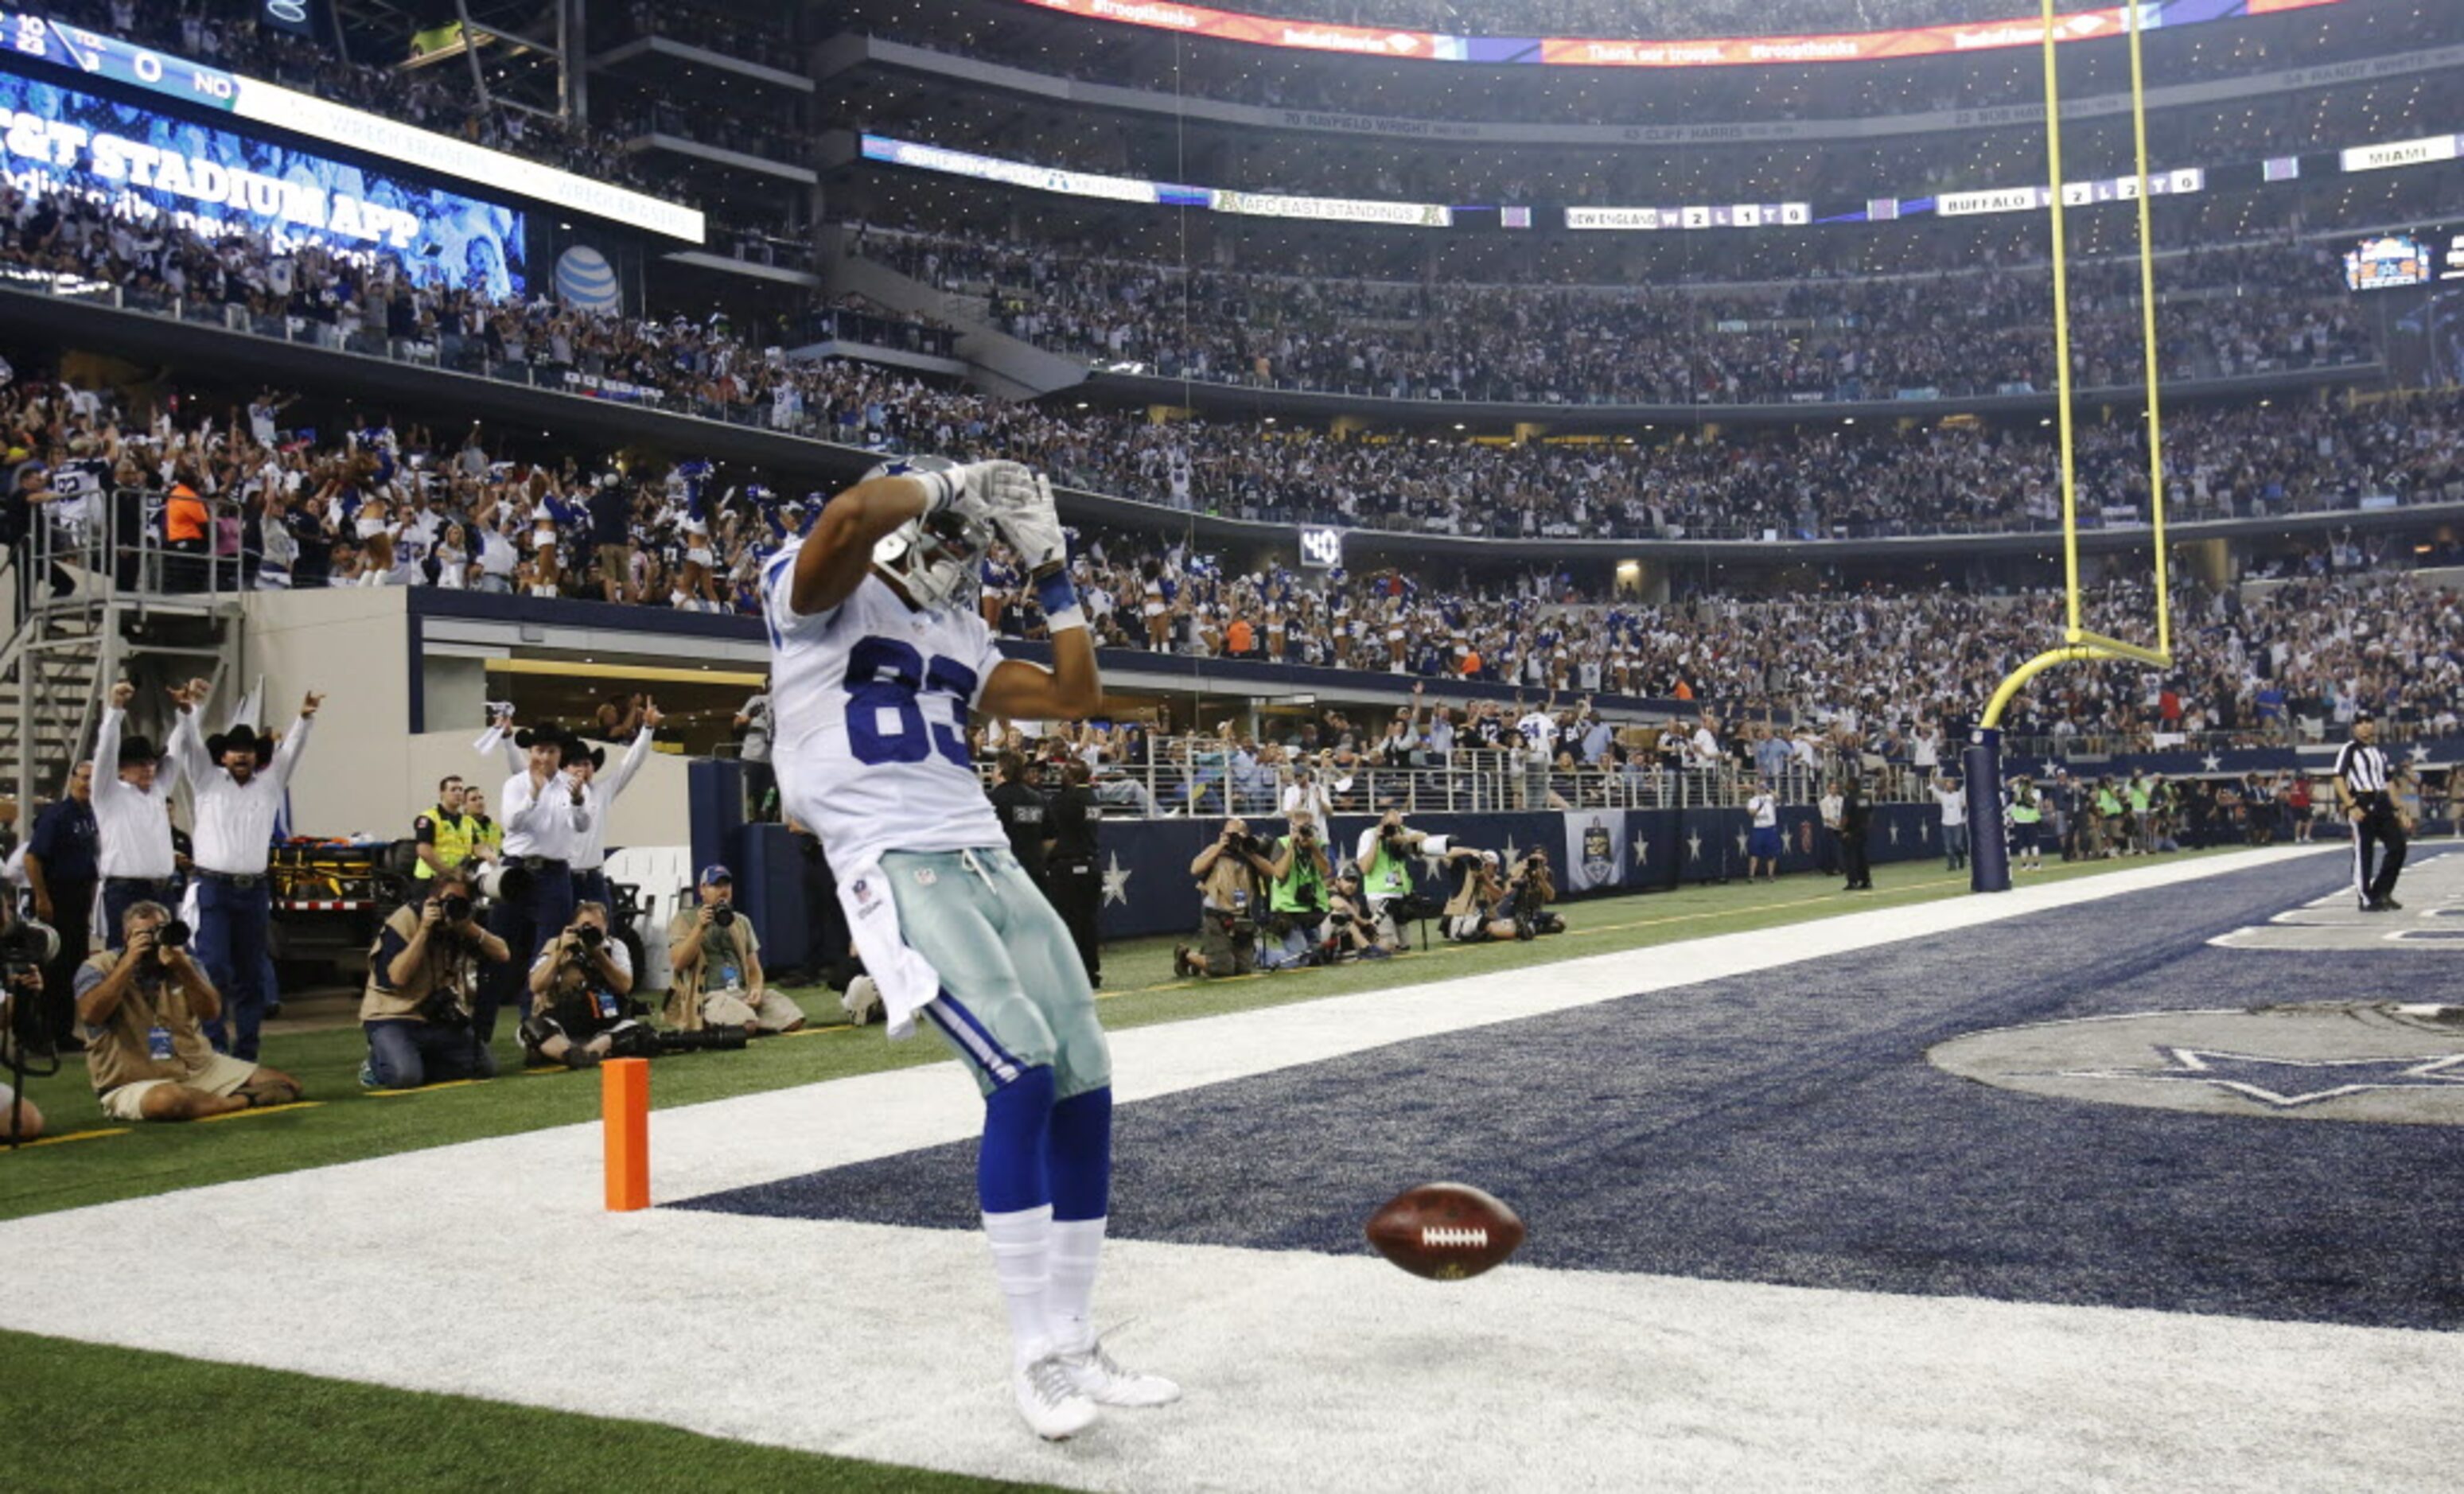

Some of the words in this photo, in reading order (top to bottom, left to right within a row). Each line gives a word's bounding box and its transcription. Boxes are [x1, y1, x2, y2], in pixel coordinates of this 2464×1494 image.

[1588, 45, 1635, 61] Thank
[193, 71, 232, 99] NO
[1285, 113, 1300, 125] 70
[1376, 119, 1429, 134] WRIGHT
[1691, 126, 1742, 139] HARRIS
[2369, 146, 2427, 164] MIAMI
[91, 131, 328, 230] STADIUM
[329, 192, 420, 249] APP
[1245, 196, 1276, 213] AFC
[1280, 198, 1320, 216] EAST
[1325, 200, 1414, 221] STANDINGS
[1948, 196, 2025, 212] BUFFALO
[2073, 191, 2083, 203] 2
[1598, 207, 1656, 225] ENGLAND
[1661, 210, 1678, 226] W
[1693, 212, 1703, 224] 2
[1716, 208, 1726, 224] L
[1763, 207, 1776, 223] T
[1303, 528, 1337, 564] 40
[843, 634, 978, 774] 83
